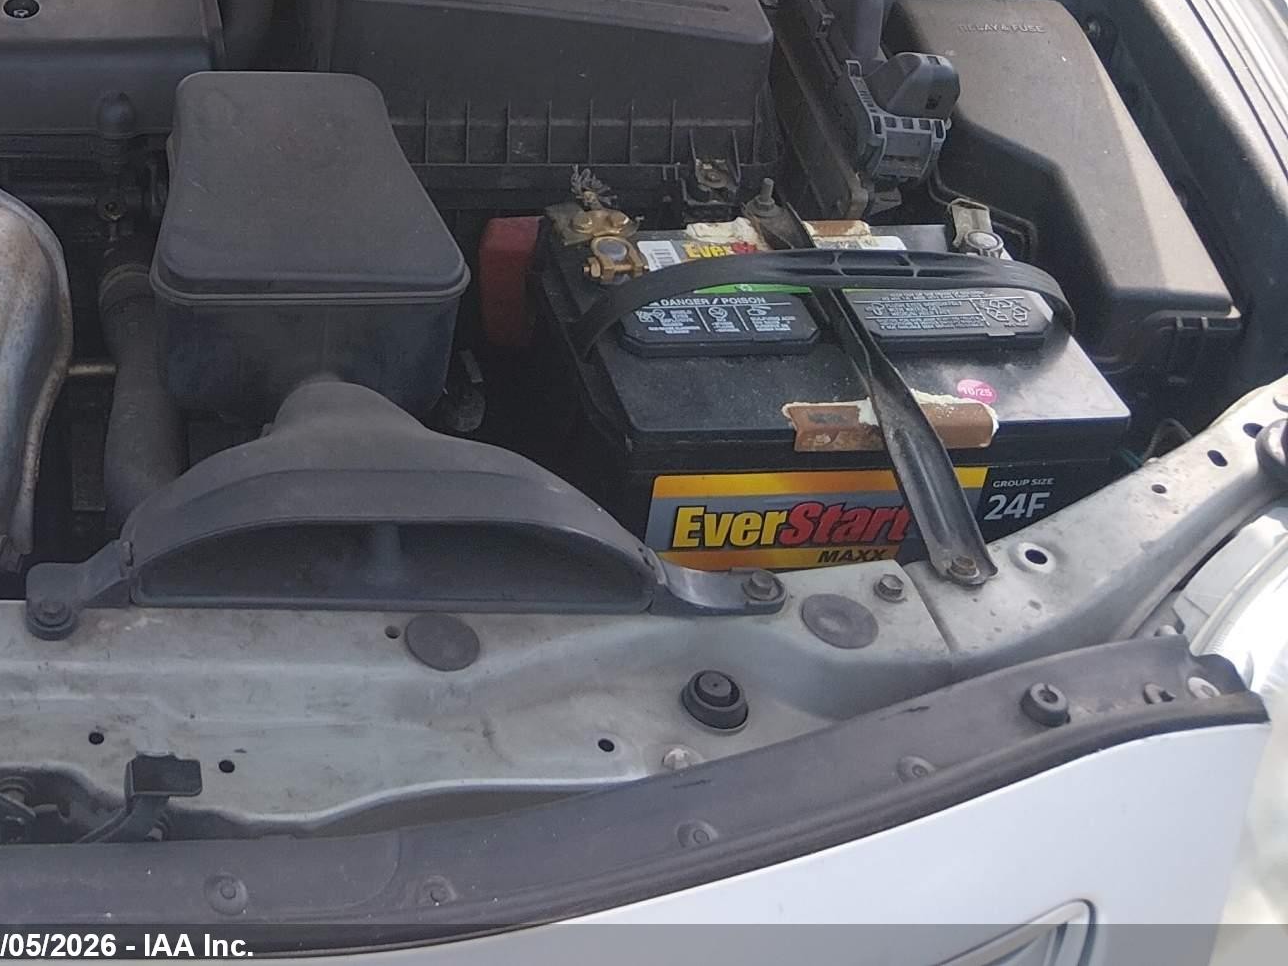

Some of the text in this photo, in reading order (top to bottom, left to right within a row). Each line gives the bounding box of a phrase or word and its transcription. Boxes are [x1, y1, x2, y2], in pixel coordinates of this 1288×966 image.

[661, 298, 711, 306] DANGER
[721, 297, 766, 305] POISON
[993, 477, 1054, 488] GROUP SIZE
[983, 492, 1050, 520] 24F
[672, 501, 911, 548] EverStart
[817, 549, 888, 563] MAXX
